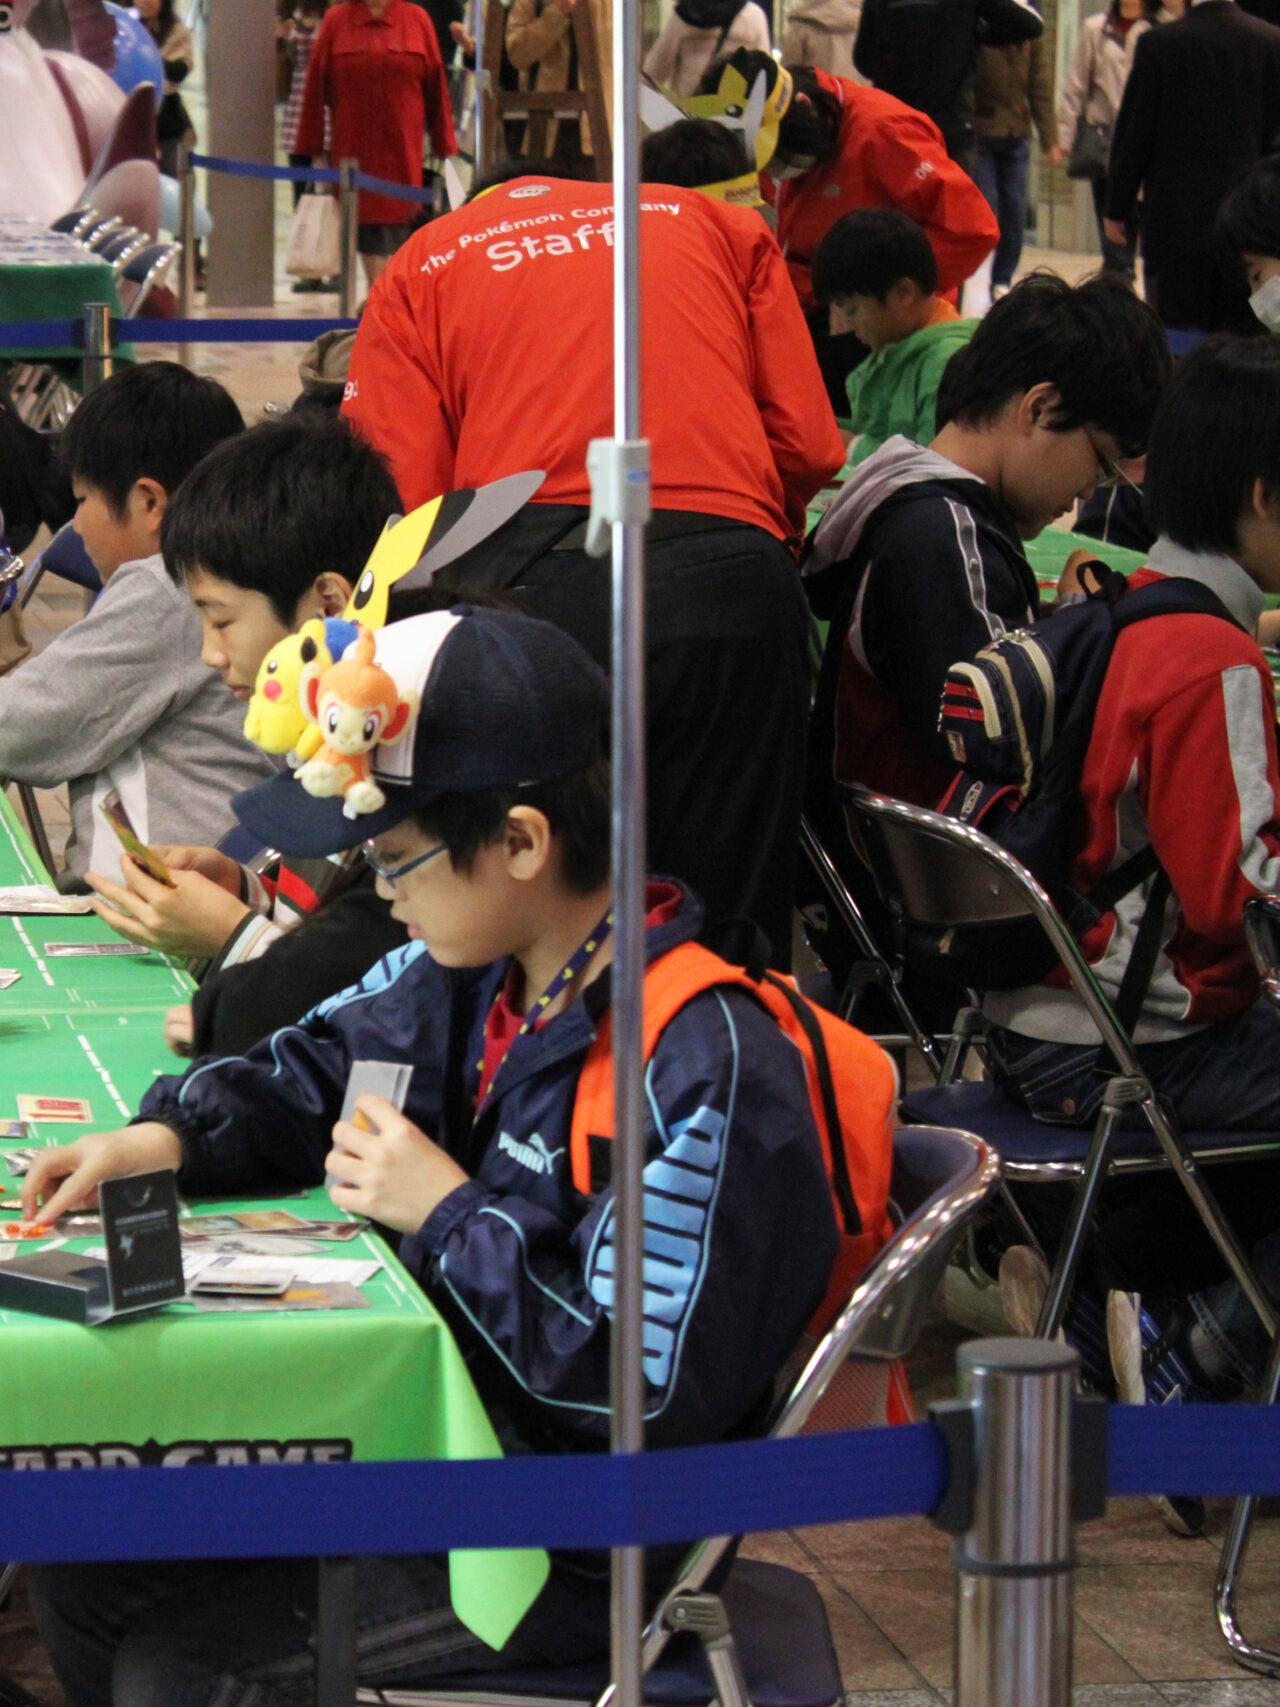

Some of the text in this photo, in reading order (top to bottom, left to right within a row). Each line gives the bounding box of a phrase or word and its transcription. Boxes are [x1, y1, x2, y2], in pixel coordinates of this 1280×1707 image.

[421, 249, 456, 274] The
[458, 212, 565, 248] Pokémon
[486, 220, 615, 272] Staff
[498, 1131, 546, 1174] PUMA
